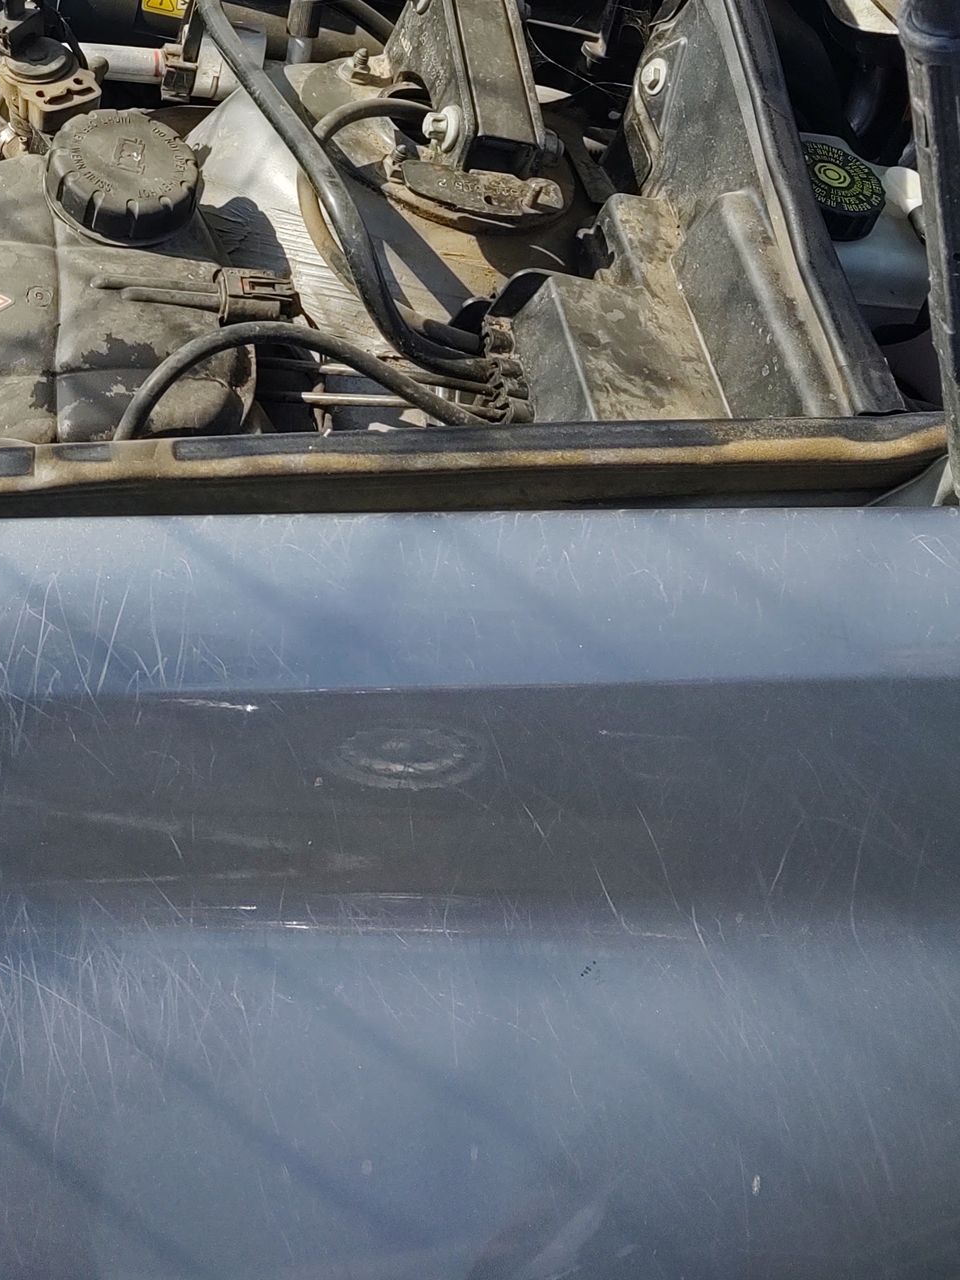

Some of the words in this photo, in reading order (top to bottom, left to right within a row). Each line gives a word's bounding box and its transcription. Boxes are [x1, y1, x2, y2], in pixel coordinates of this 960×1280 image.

[151, 127, 167, 138] DO
[164, 138, 180, 152] NOT
[72, 147, 87, 170] WENN
[847, 156, 869, 174] CLEAN
[137, 189, 158, 199] HOT
[871, 195, 881, 206] CAP
[842, 202, 872, 211] BEFORE
